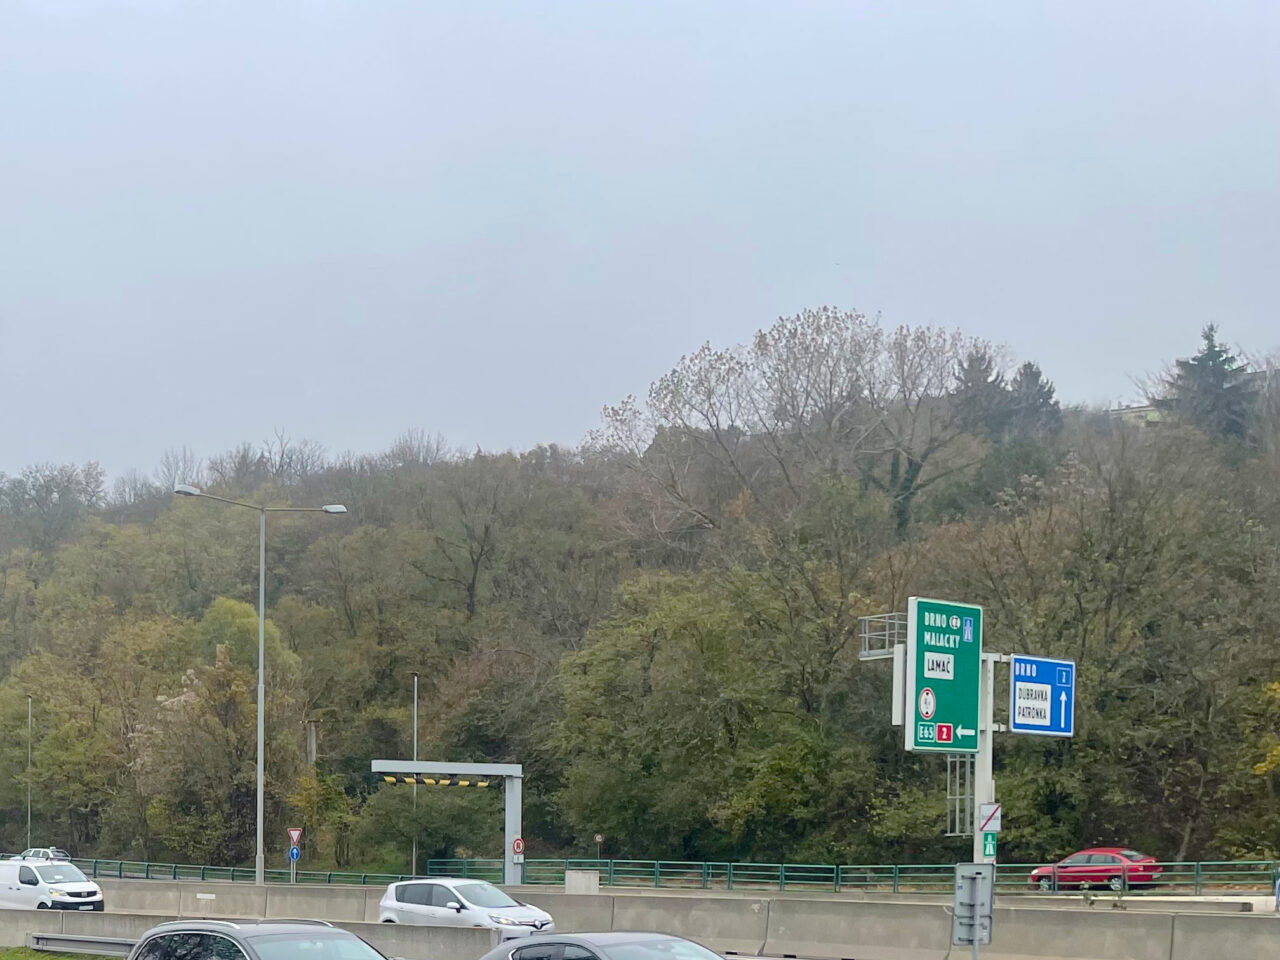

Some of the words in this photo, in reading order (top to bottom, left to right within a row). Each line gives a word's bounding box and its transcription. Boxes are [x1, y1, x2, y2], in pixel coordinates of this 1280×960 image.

[924, 612, 947, 628] BRNO
[924, 631, 960, 648] MALACKY
[927, 657, 950, 674] LAMAČ
[1015, 662, 1037, 677] BRNO
[919, 725, 934, 738] E65
[941, 727, 948, 739] 2
